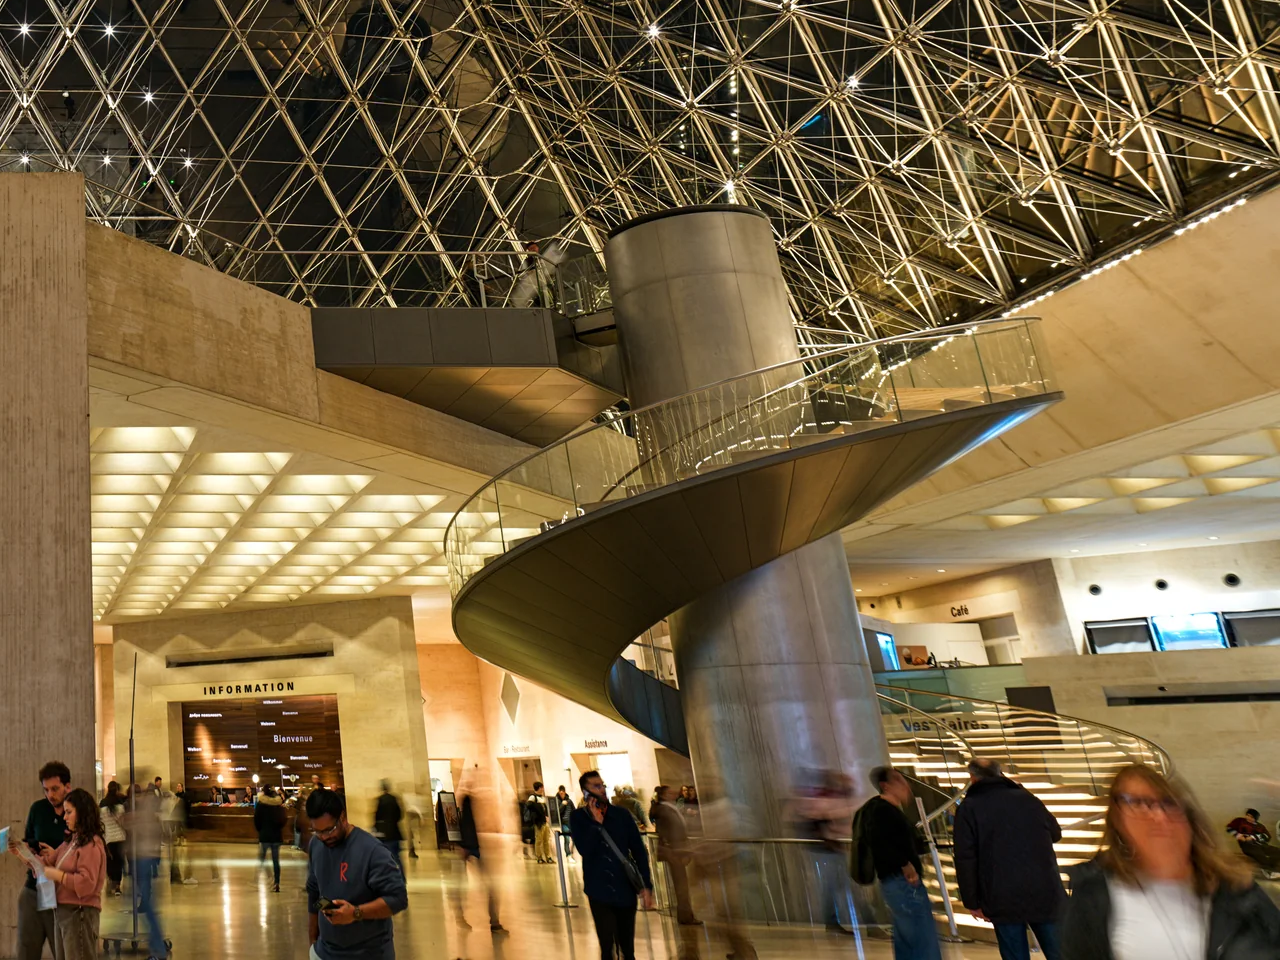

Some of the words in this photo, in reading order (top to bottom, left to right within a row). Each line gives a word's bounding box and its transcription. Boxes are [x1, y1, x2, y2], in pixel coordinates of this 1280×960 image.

[950, 604, 969, 617] Café
[203, 682, 294, 695] INFORMATION
[900, 717, 989, 732] Vesiaires
[340, 862, 348, 882] R
